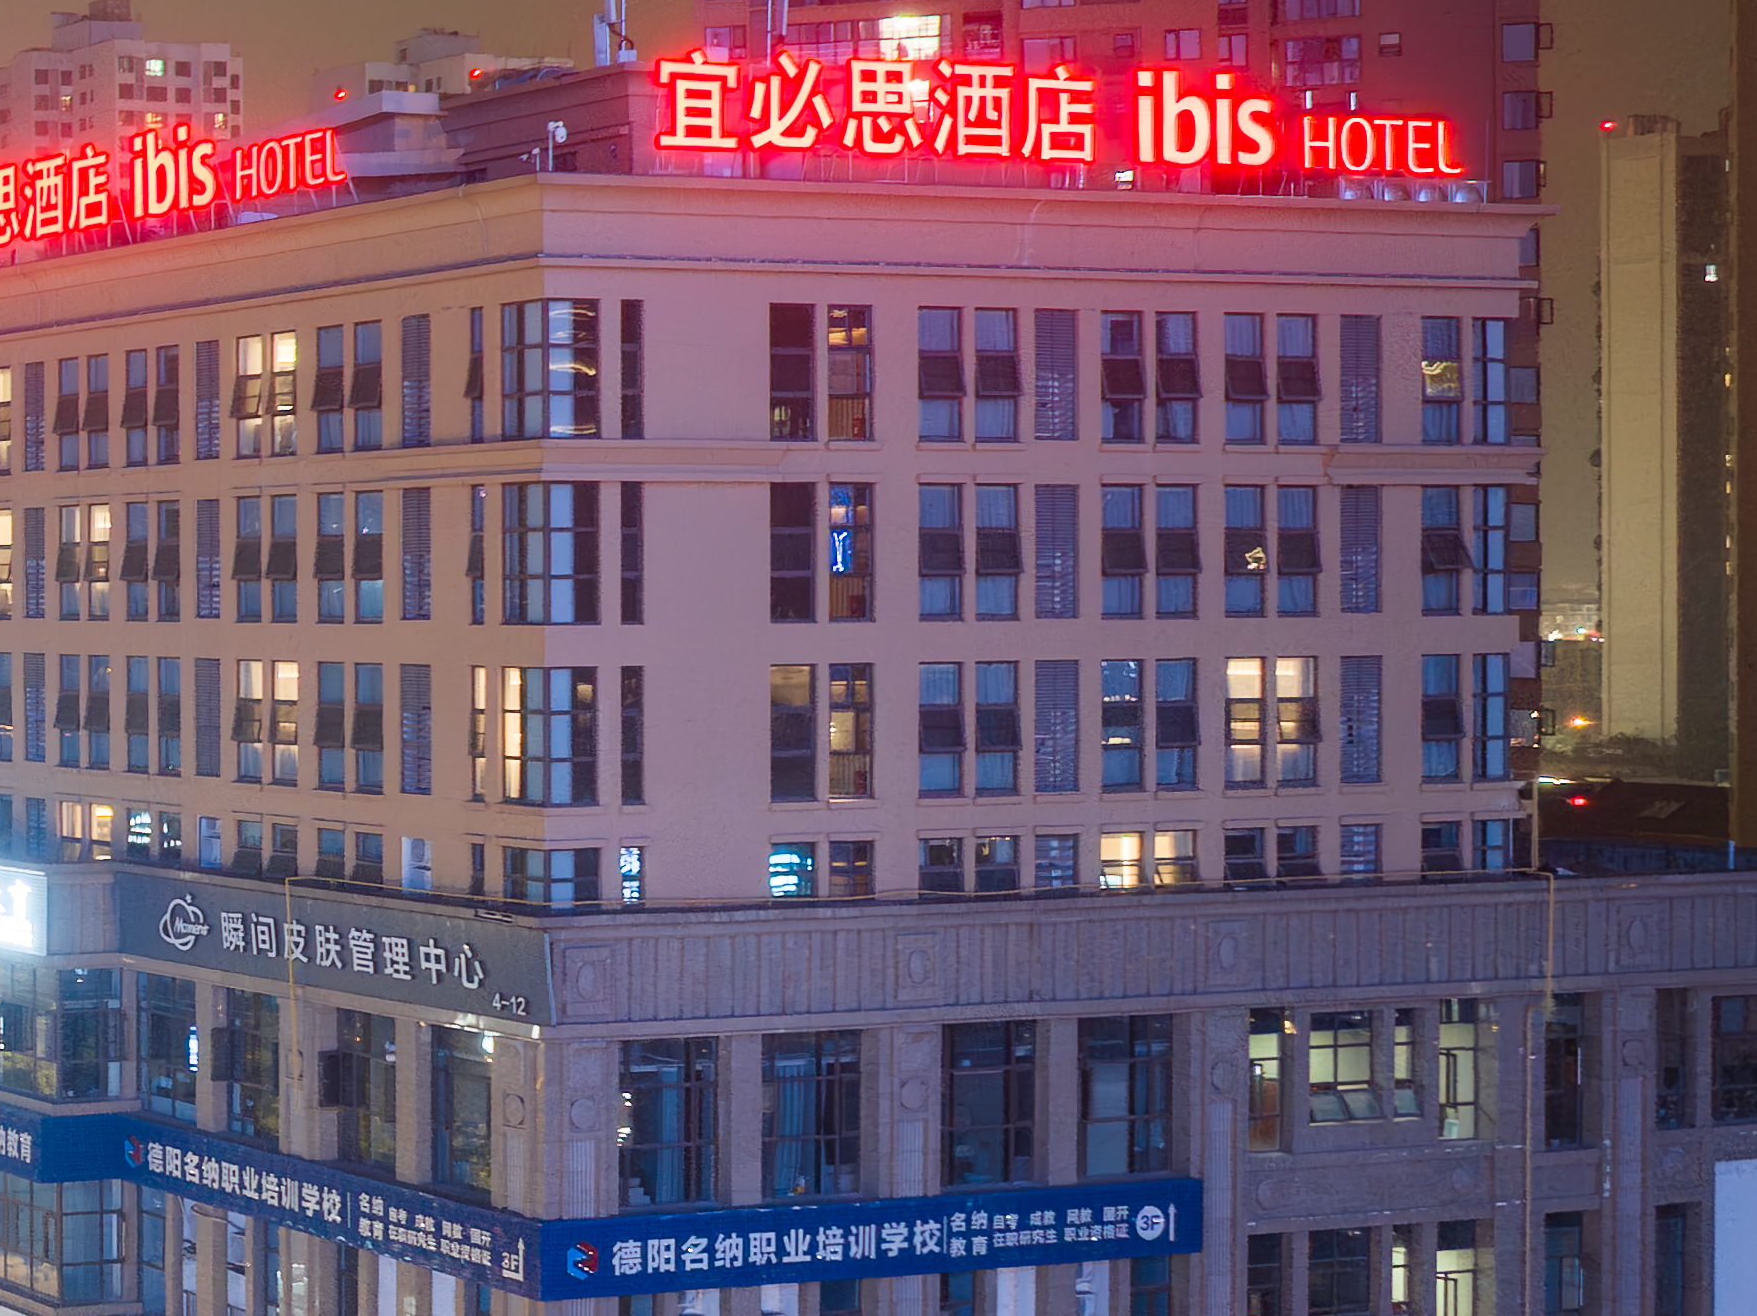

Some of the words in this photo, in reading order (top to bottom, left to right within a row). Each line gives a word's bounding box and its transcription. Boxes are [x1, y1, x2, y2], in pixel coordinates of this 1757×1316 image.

[657, 50, 1097, 164] 宜必思酒店
[1137, 70, 1275, 166] ibis
[1303, 117, 1465, 175] HOTEL
[131, 123, 217, 218] ibis
[234, 129, 347, 201] HOTEL
[219, 908, 486, 991] 瞬间皮肤管理中心
[491, 991, 529, 1017] 4-12
[146, 1141, 343, 1226] 德阳名纳职业培训学校
[357, 1191, 385, 1218] 名纳
[357, 1215, 385, 1242] 教育
[949, 1209, 989, 1233] 名纳
[1140, 1214, 1165, 1233] 3F
[611, 1218, 944, 1278] 德阳名纳职业培训学校
[949, 1235, 989, 1258] 教育
[992, 1228, 1058, 1248] 在职研究生
[1063, 1223, 1131, 1242] 职业资格证
[501, 1251, 520, 1271] 3F
